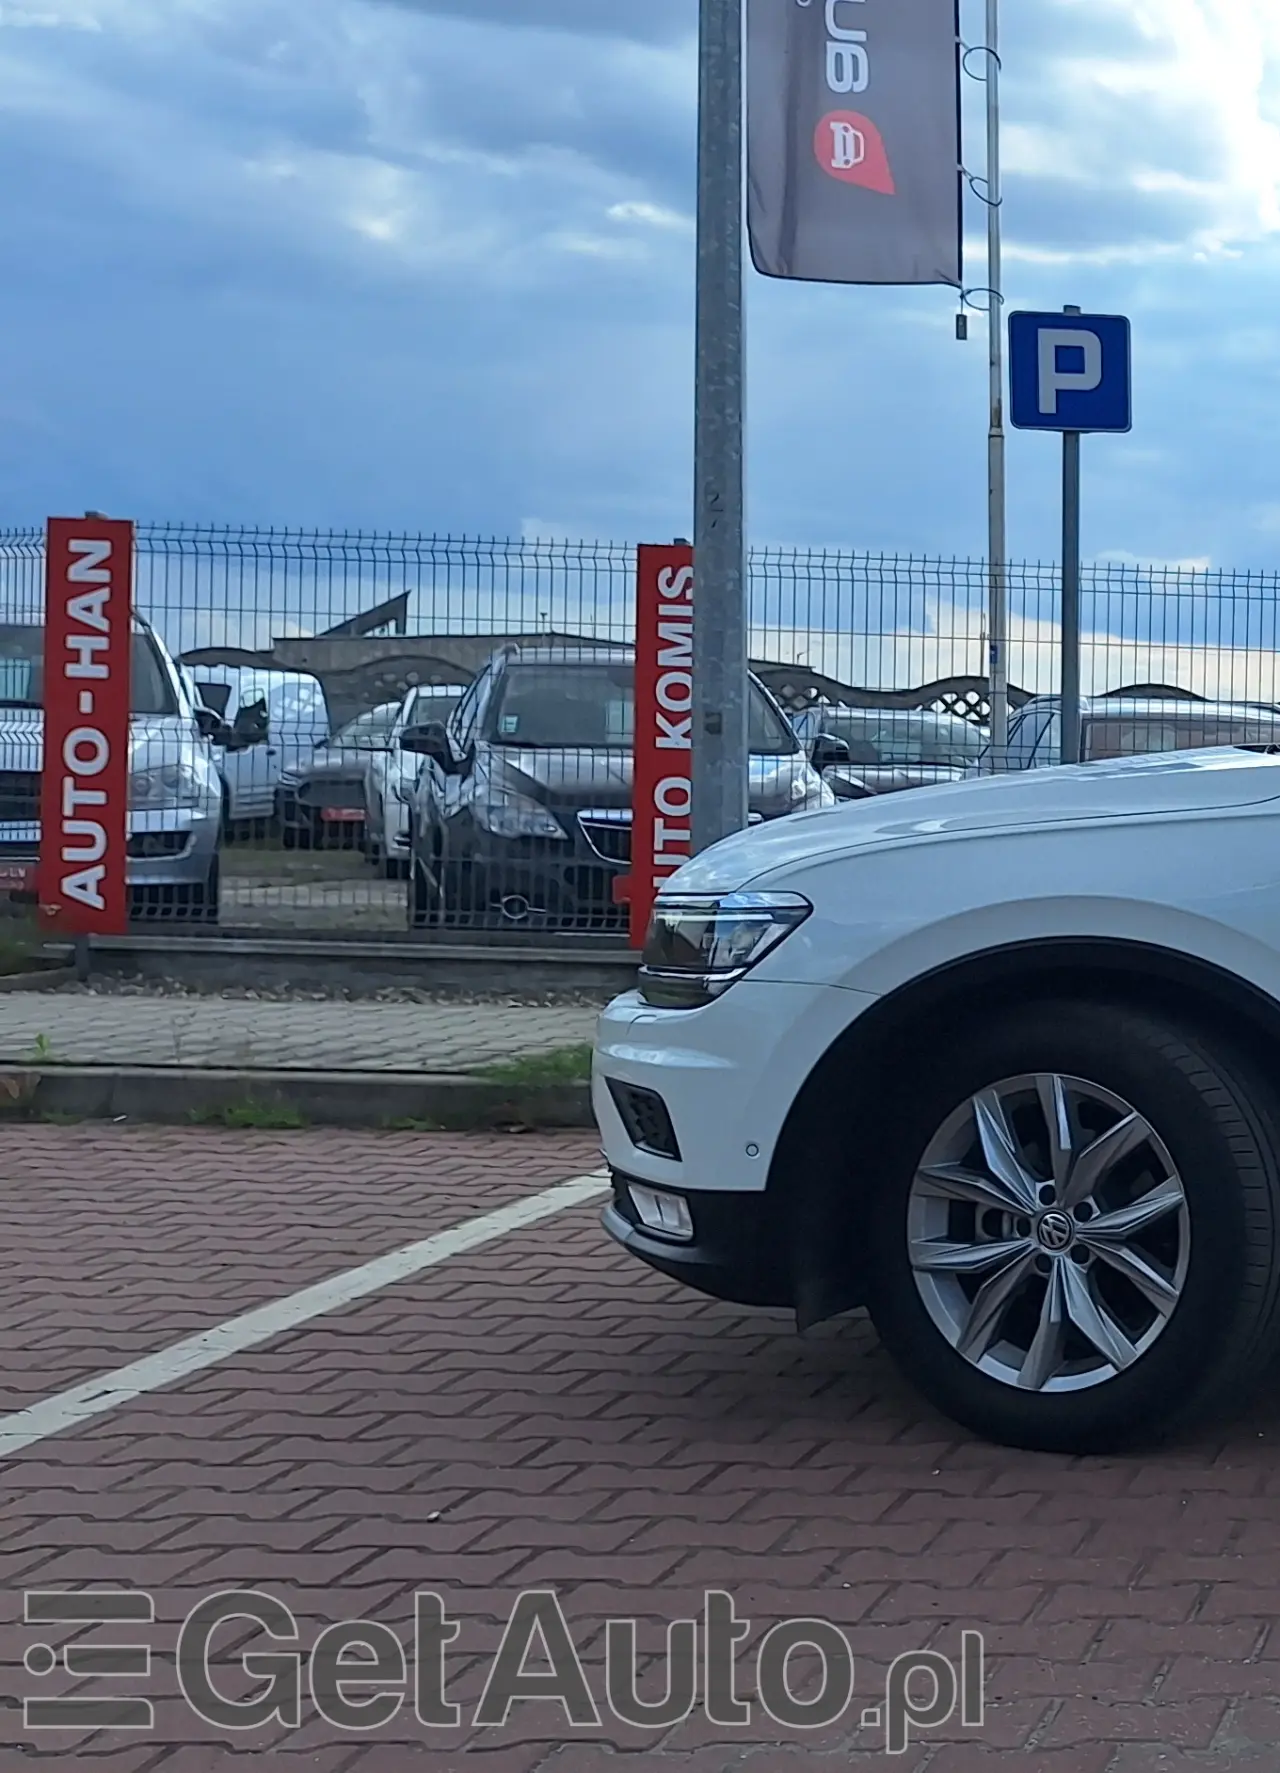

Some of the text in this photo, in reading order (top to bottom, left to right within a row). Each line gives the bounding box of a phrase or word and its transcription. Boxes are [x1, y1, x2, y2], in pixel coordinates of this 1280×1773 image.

[1037, 328, 1102, 414] P
[62, 538, 113, 911] AUTO-HAN
[655, 564, 694, 749] KOMIS
